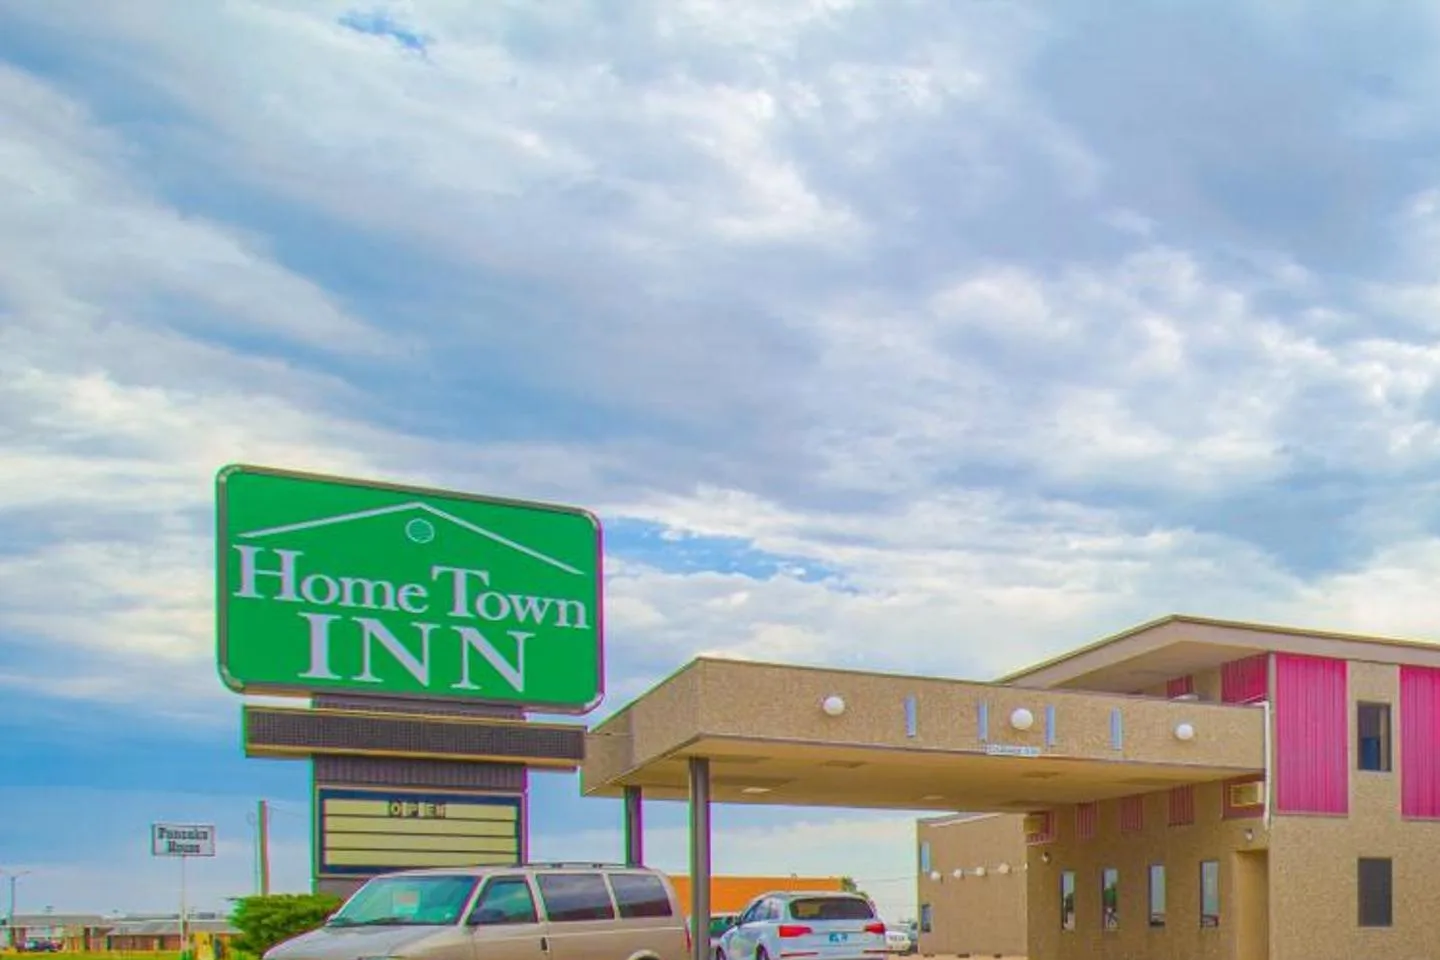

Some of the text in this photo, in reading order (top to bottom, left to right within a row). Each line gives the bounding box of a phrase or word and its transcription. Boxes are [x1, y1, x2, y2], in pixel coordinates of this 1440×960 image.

[233, 544, 591, 629] Home Town
[298, 612, 535, 692] INN
[388, 799, 446, 818] OPEN
